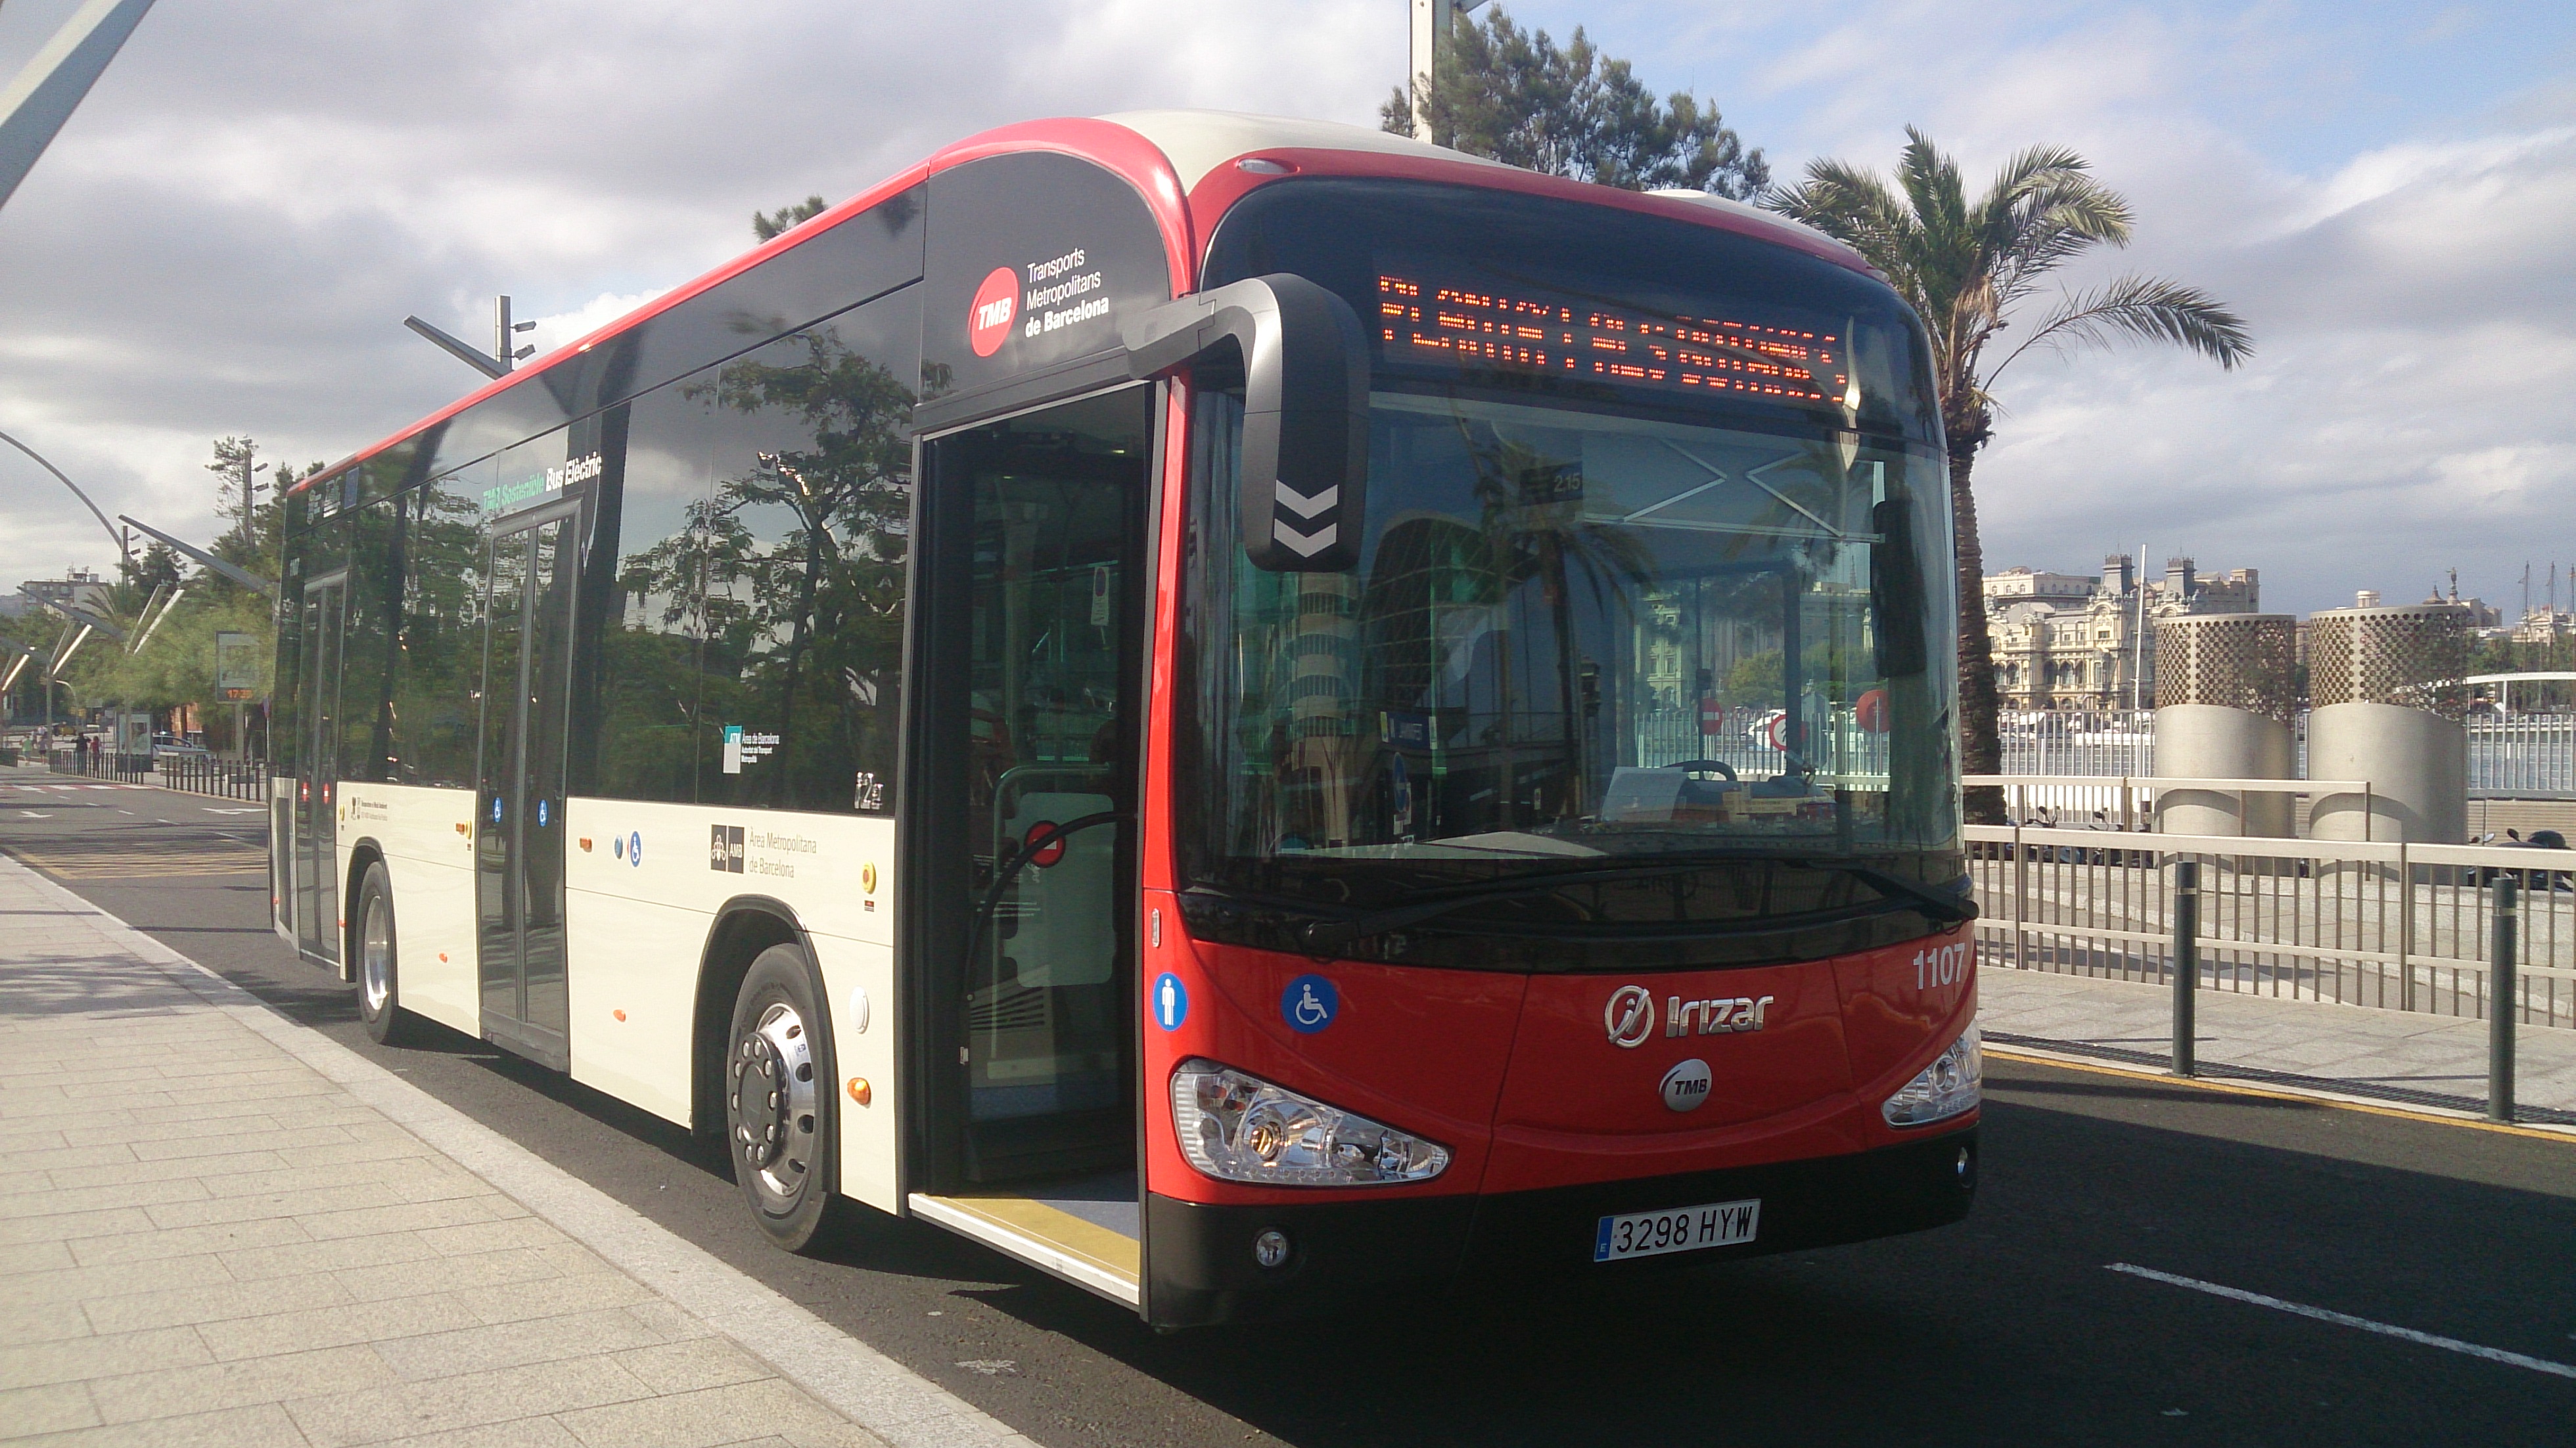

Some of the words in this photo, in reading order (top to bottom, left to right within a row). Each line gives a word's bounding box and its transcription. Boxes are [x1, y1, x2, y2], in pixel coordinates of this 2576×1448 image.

[1027, 248, 1085, 283] Transports
[1026, 271, 1101, 311] Metropolitans
[978, 297, 1012, 330] TMB
[1025, 317, 1041, 337] de
[1044, 297, 1109, 332] Barcelona
[545, 467, 564, 492] Bus
[564, 451, 602, 486] Elèctric
[729, 733, 741, 744] ATM
[758, 732, 779, 744] Barcelona
[729, 843, 743, 859] AMB
[750, 826, 765, 848] Àrea
[766, 832, 817, 855] Metropolitana
[749, 857, 758, 873] de
[759, 859, 794, 878] Barcelona
[1913, 943, 1966, 989] 1107
[1666, 996, 1774, 1037] Irizar
[1674, 1078, 1708, 1096] TMB
[1599, 1243, 1607, 1253] E
[1616, 1213, 1690, 1253] 3298
[1698, 1206, 1753, 1243] HYW
